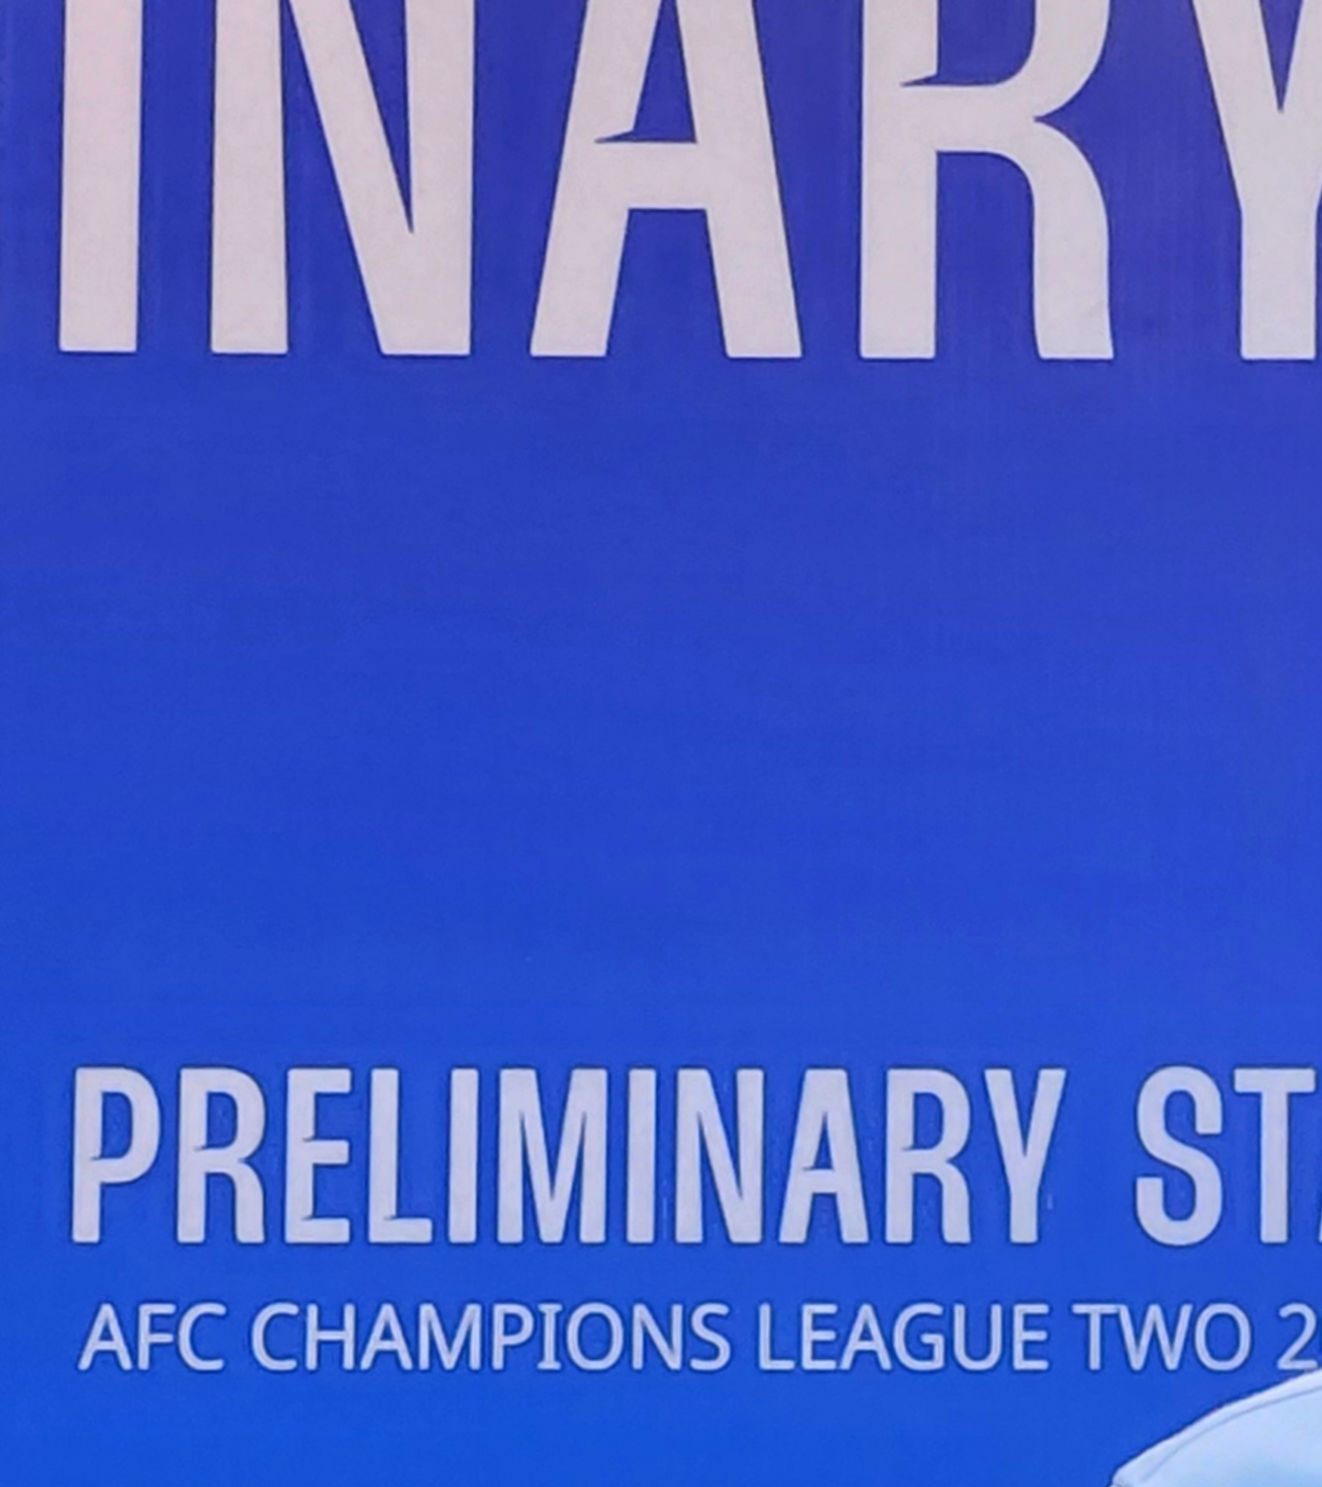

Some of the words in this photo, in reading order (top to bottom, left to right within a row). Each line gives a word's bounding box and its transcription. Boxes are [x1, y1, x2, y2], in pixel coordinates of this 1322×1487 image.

[71, 1066, 1067, 1245] PRELIMINARY
[77, 1302, 226, 1371] AFC
[251, 1302, 731, 1371] CHAMPIONS
[759, 1302, 1050, 1371] LEAGUE
[1072, 1302, 1251, 1371] TWO
